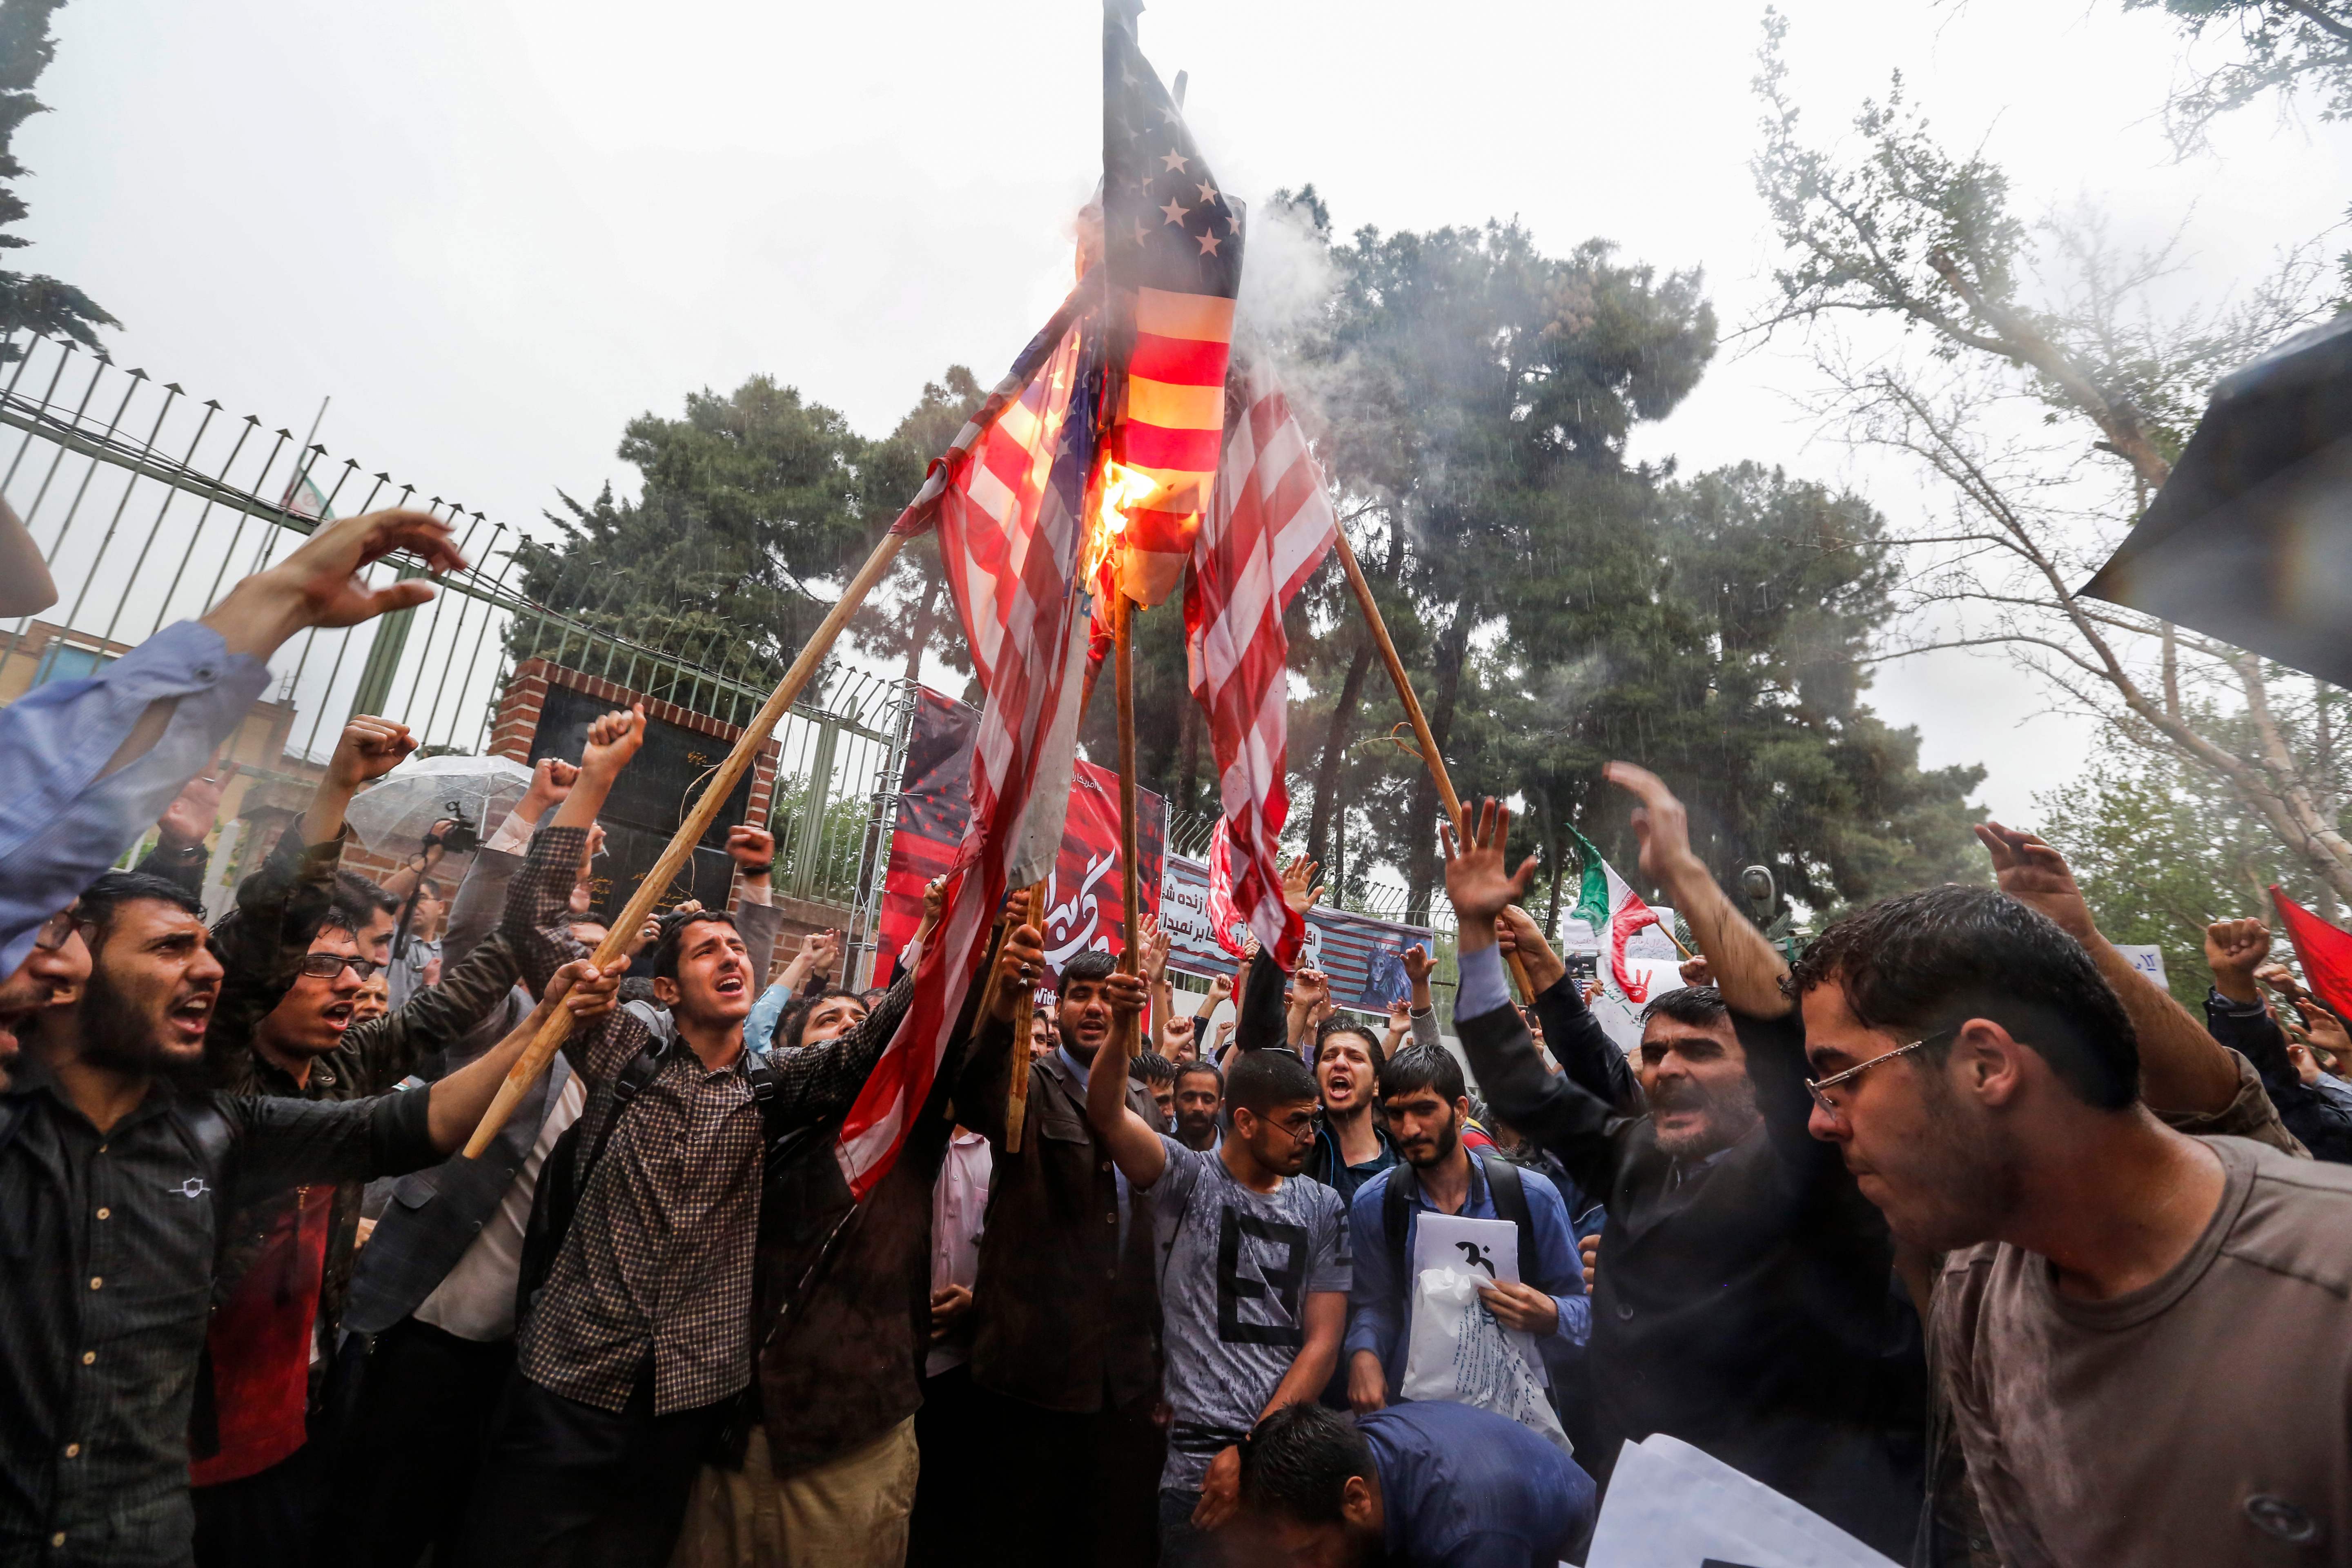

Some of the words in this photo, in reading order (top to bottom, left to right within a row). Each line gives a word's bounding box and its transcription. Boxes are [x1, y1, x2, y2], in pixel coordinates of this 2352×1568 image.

[1077, 773, 1097, 788] آمریکا
[1097, 781, 1102, 792] ما
[1178, 894, 1203, 915] زنده
[1193, 928, 1204, 943] بر
[1034, 987, 1057, 1006] With
